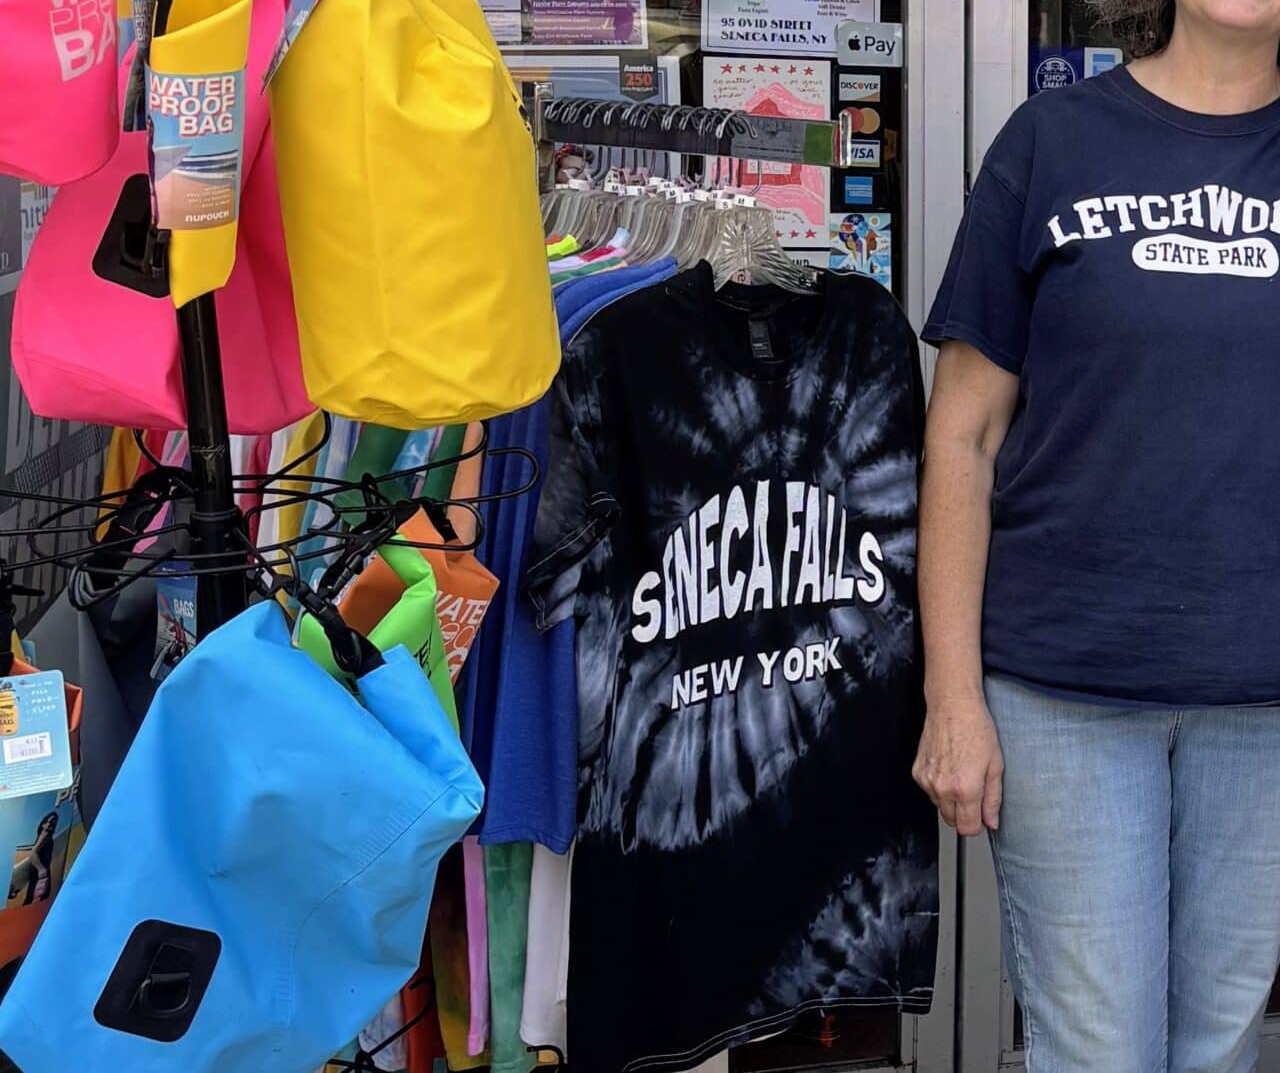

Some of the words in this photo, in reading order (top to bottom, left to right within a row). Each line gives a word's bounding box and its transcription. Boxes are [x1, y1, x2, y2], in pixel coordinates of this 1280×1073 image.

[721, 18, 735, 26] 95
[738, 19, 767, 29] OVID
[770, 20, 812, 31] STREET
[721, 30, 768, 42] SENECA
[770, 32, 808, 44] FALLS,
[812, 34, 827, 45] NY
[865, 36, 895, 56] Pay
[624, 64, 653, 72] America
[150, 76, 235, 96] WATER
[626, 73, 653, 86] 250
[841, 81, 878, 91] DISCOVER
[150, 93, 235, 116] PROOF
[180, 113, 233, 136] BAG
[1145, 242, 1209, 267] STATE
[1219, 247, 1267, 268] PARK
[631, 479, 773, 643] SENECA
[781, 480, 885, 607] FALLS
[670, 655, 744, 710] NEW
[756, 635, 841, 687] YORK
